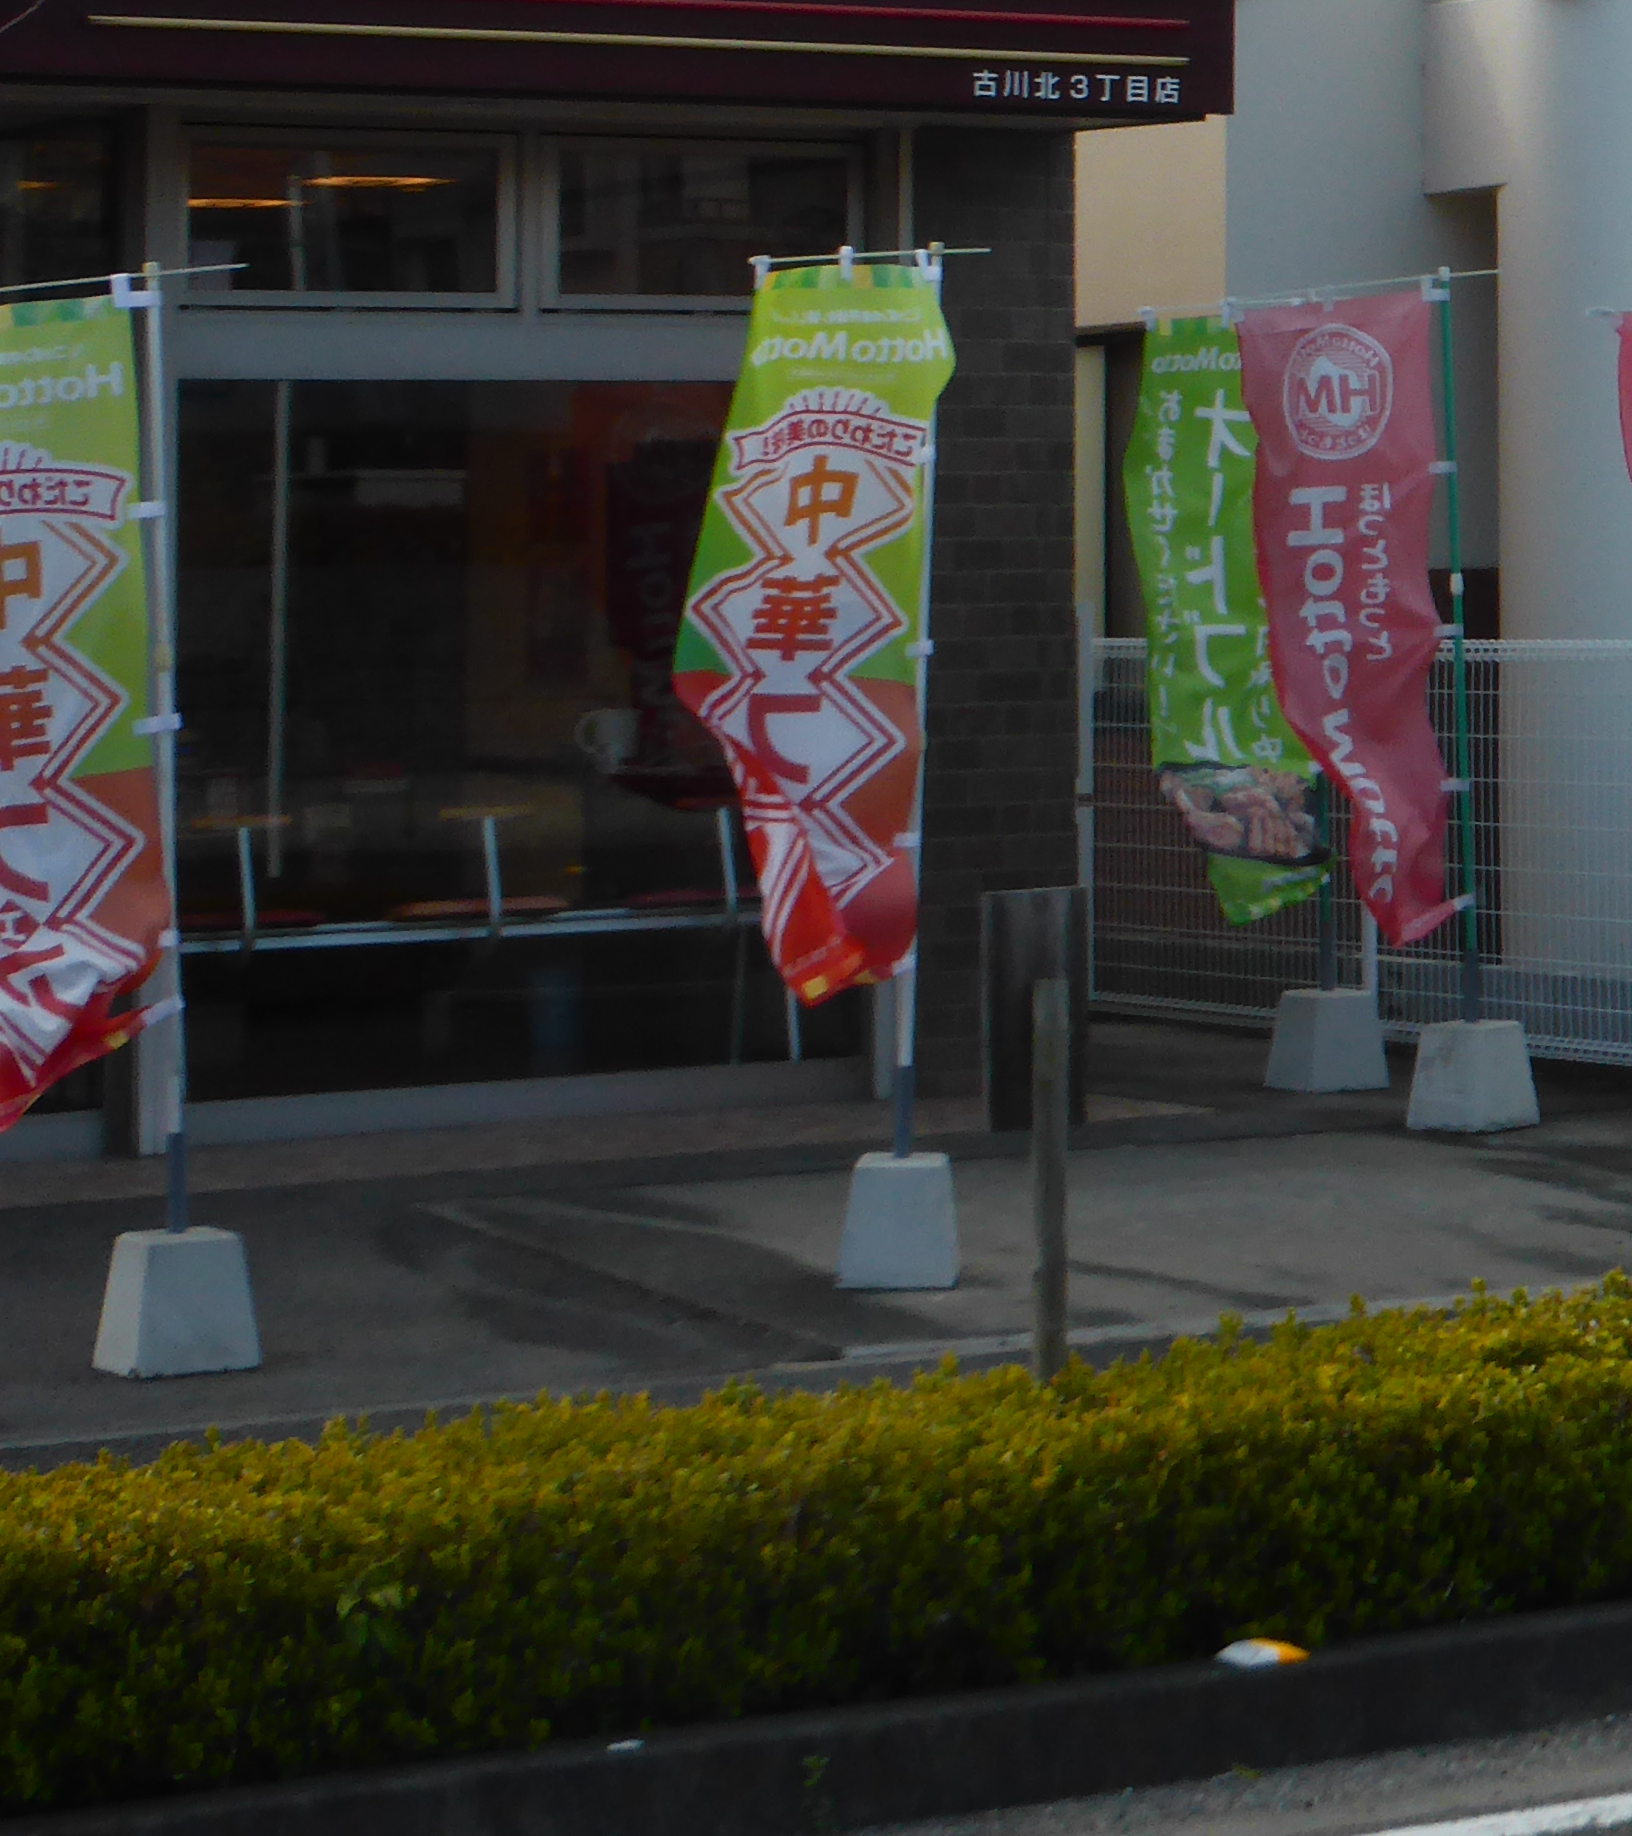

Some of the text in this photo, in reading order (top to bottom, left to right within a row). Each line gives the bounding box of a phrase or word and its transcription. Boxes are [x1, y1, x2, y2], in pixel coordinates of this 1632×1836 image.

[972, 68, 1181, 105] 古川北3丁目店
